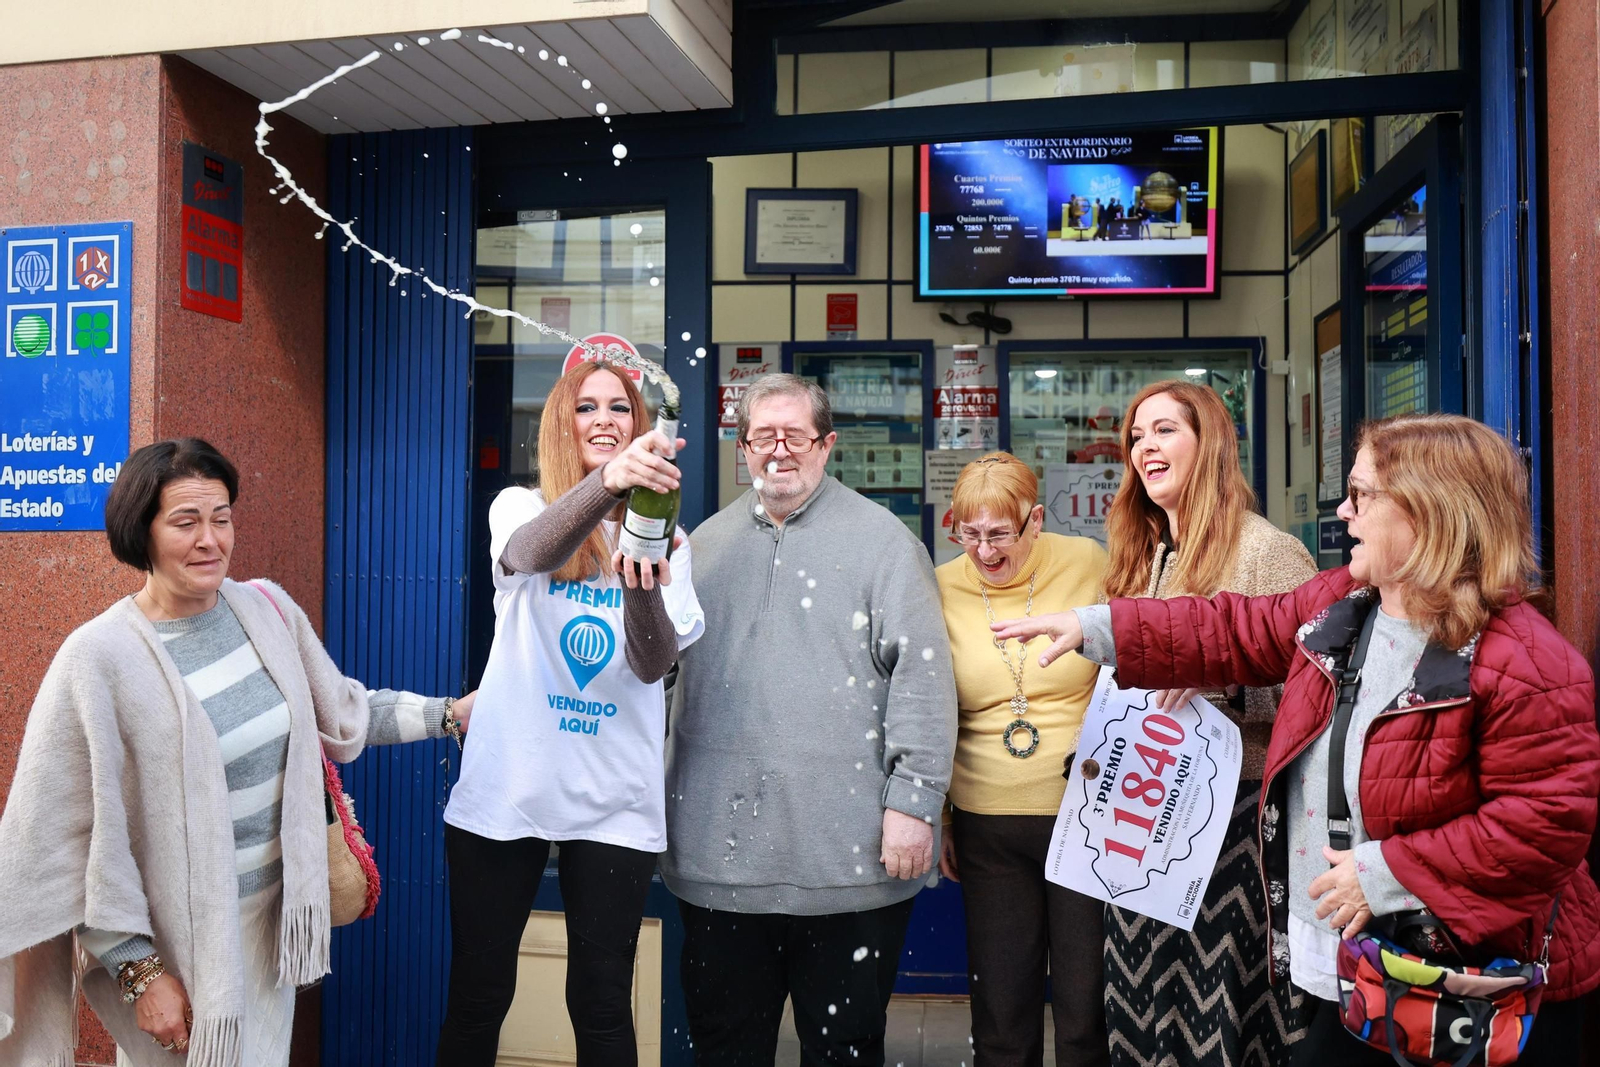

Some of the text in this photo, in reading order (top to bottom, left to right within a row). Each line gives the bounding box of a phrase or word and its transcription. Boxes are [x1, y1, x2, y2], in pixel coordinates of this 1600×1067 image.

[1004, 137, 1132, 148] SORTEO EXTRAORDINARIO
[1028, 148, 1107, 159] DE NAVIDAD
[954, 174, 1023, 183] Cuartos Premios
[959, 185, 984, 193] 77768
[971, 198, 1004, 206] 200.000€
[956, 214, 1019, 224] Quintos Premios
[187, 214, 239, 249] Alarma
[973, 246, 1002, 254] 60.000€
[80, 250, 108, 274] 1 X
[1391, 251, 1423, 280] RESULTADOS
[1008, 276, 1032, 284] Quinto
[1033, 276, 1059, 285] premio
[1081, 277, 1097, 285] muy
[1098, 275, 1133, 284] repartido.
[728, 363, 774, 381] Direct
[944, 364, 989, 383] Direct
[846, 396, 893, 408] NAVIDAD
[936, 389, 997, 404] Alarma
[1, 431, 95, 456] Loterías y
[0, 462, 122, 490] Apuestas del
[1094, 482, 1120, 490] PREM
[0, 496, 64, 518] Estado
[1069, 493, 1116, 518] 118
[548, 577, 622, 609] PREMI
[547, 693, 618, 717] VENDIDO
[1099, 705, 1105, 713] 22
[1101, 697, 1108, 706] DE
[559, 716, 600, 736] AQUÍ
[1096, 737, 1127, 804] PREMIO
[1190, 774, 1196, 783] DE
[1104, 713, 1185, 868] 11840
[1153, 753, 1192, 844] VENDIDO AQUÍ
[1179, 783, 1193, 815] MUÑEQUITA
[1182, 784, 1202, 830] SAN FERNANDO
[1176, 814, 1183, 823] LA
[1053, 808, 1075, 876] LOTERÍA DE NAVIDAD
[1161, 823, 1179, 864] ADMINISTRACIÓN
[1184, 880, 1196, 905] LOTERÍA
[1189, 877, 1204, 906] NACIONAL
